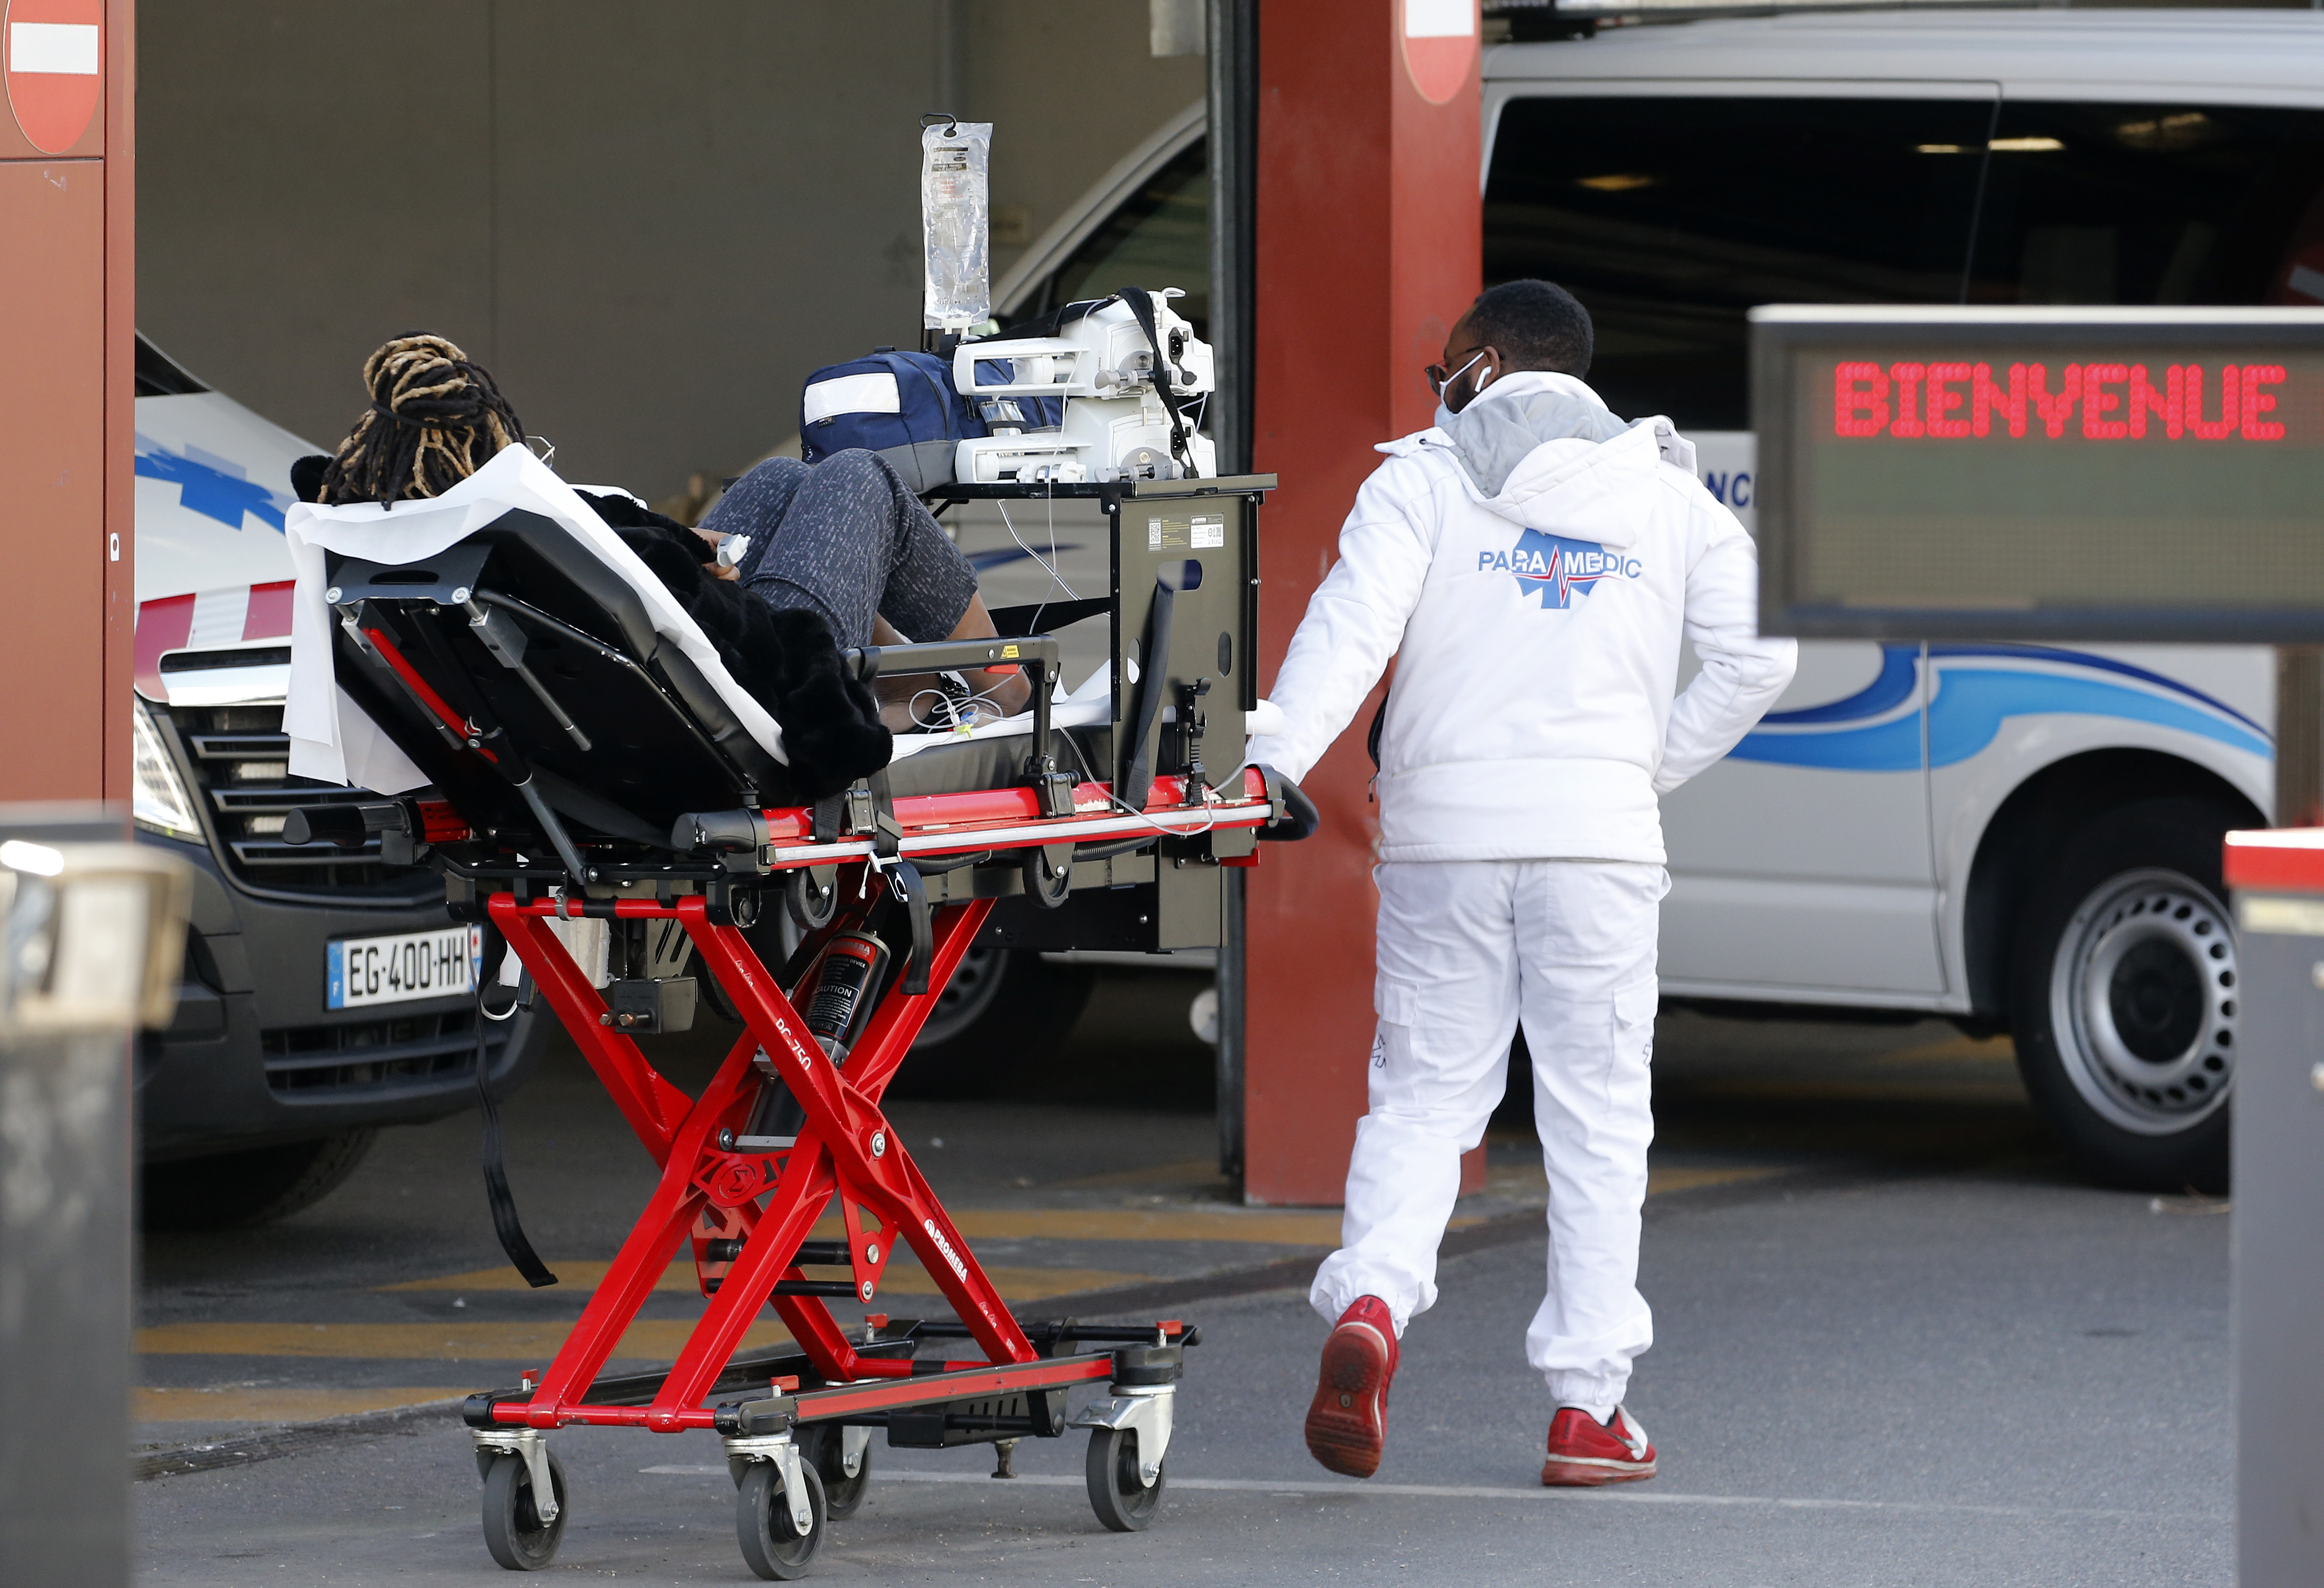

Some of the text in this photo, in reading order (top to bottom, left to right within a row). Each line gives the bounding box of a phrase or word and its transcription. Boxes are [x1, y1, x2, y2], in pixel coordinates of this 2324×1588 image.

[1834, 361, 2286, 440] BIENVENUE
[1478, 550, 1642, 578] PARAMEDIC
[350, 936, 463, 996] EG-400-HH
[849, 959, 866, 968] DEVICE
[815, 985, 852, 997] CAUTION
[776, 1018, 811, 1071] DC-750
[934, 1229, 968, 1282] PROMEBA
